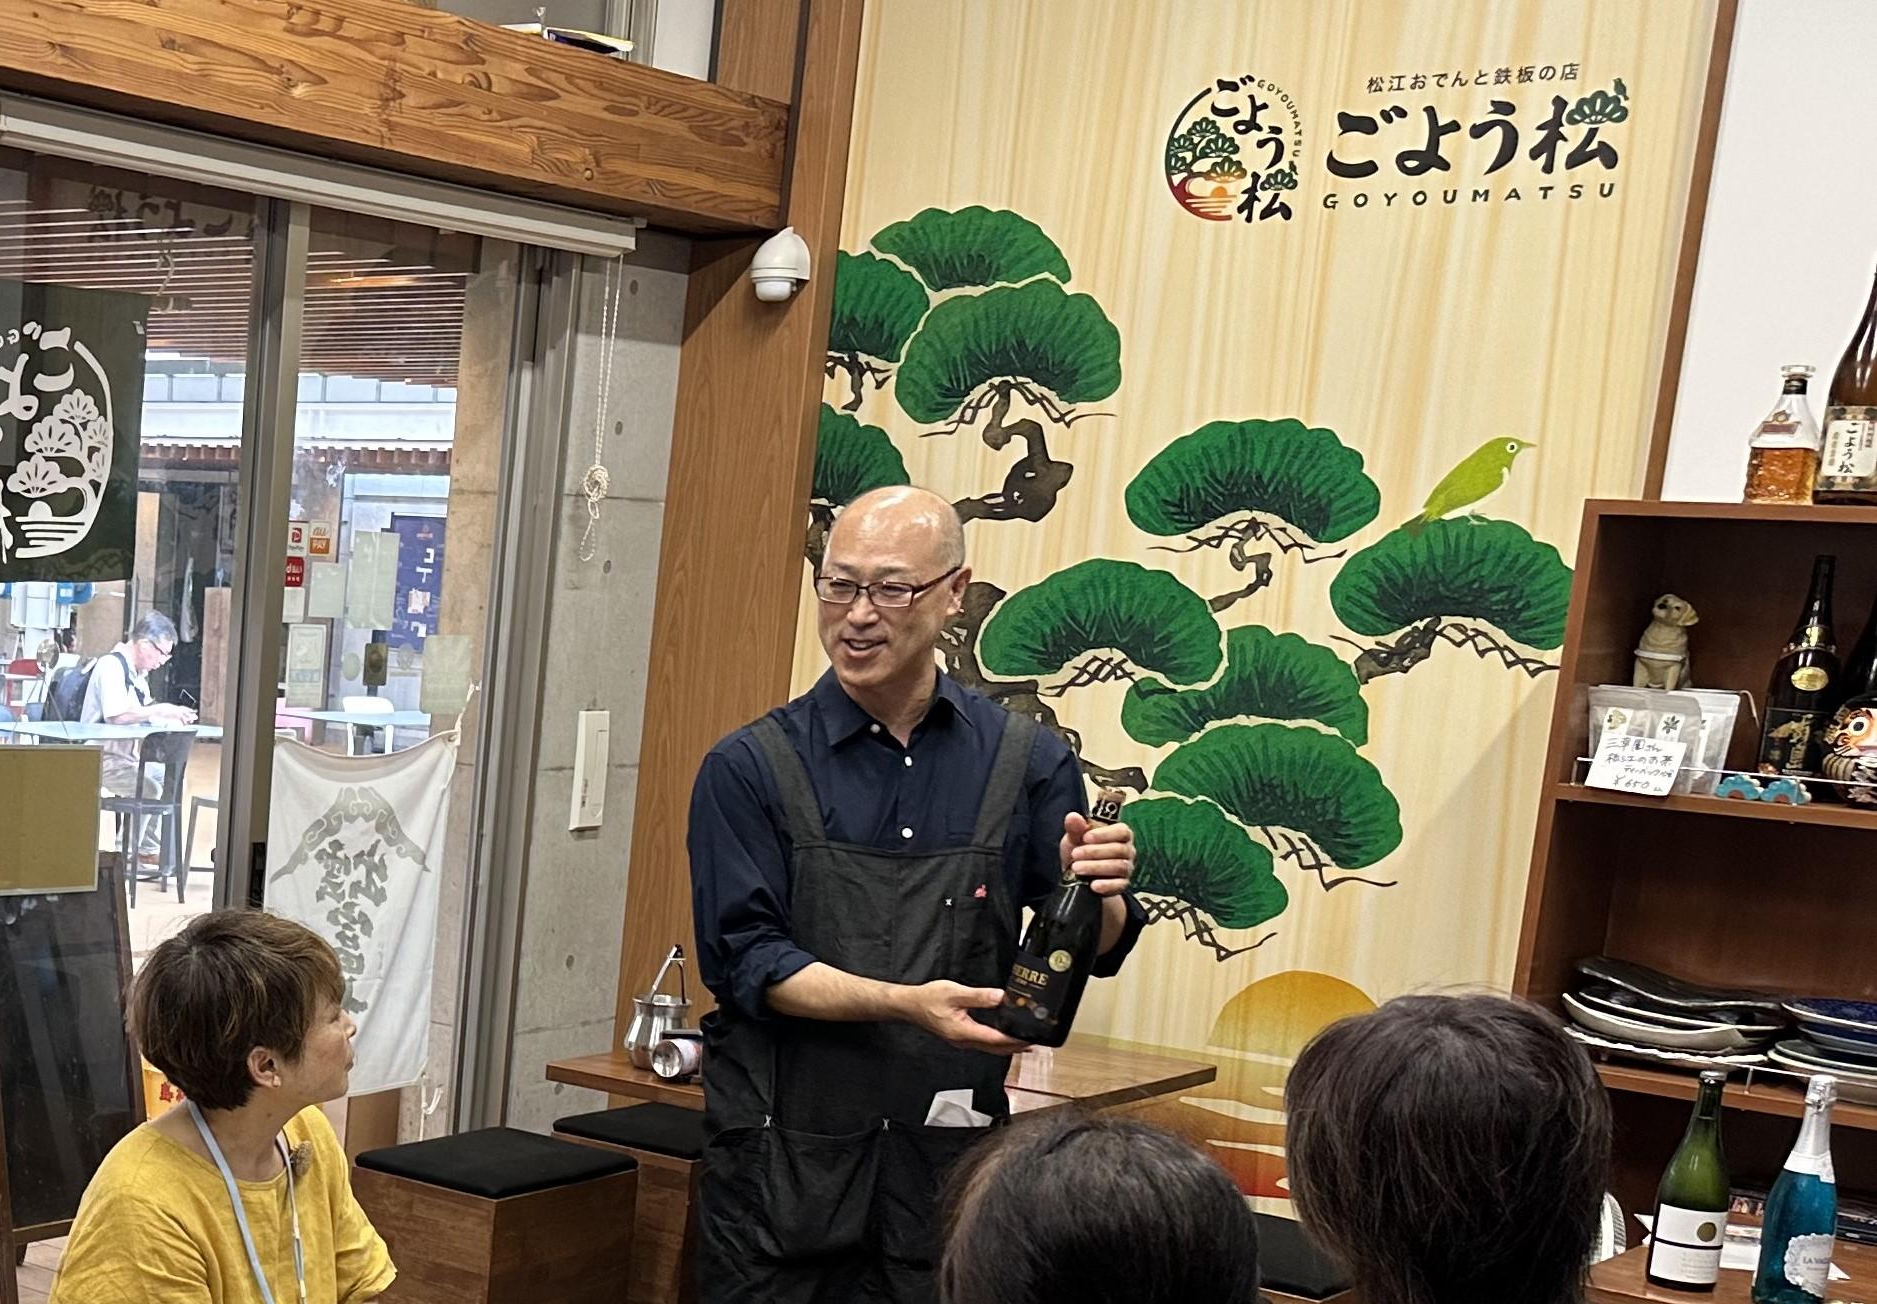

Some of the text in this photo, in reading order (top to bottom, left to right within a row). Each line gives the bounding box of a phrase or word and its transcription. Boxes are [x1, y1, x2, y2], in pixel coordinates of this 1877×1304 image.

[1367, 63, 1581, 94] 松江おでんと鉄板の店
[1211, 75, 1298, 223] ごよう松
[1257, 79, 1303, 158] GOYOUMATSU
[1326, 84, 1629, 178] ごよう松
[1323, 182, 1616, 210] GOYOUMATSU
